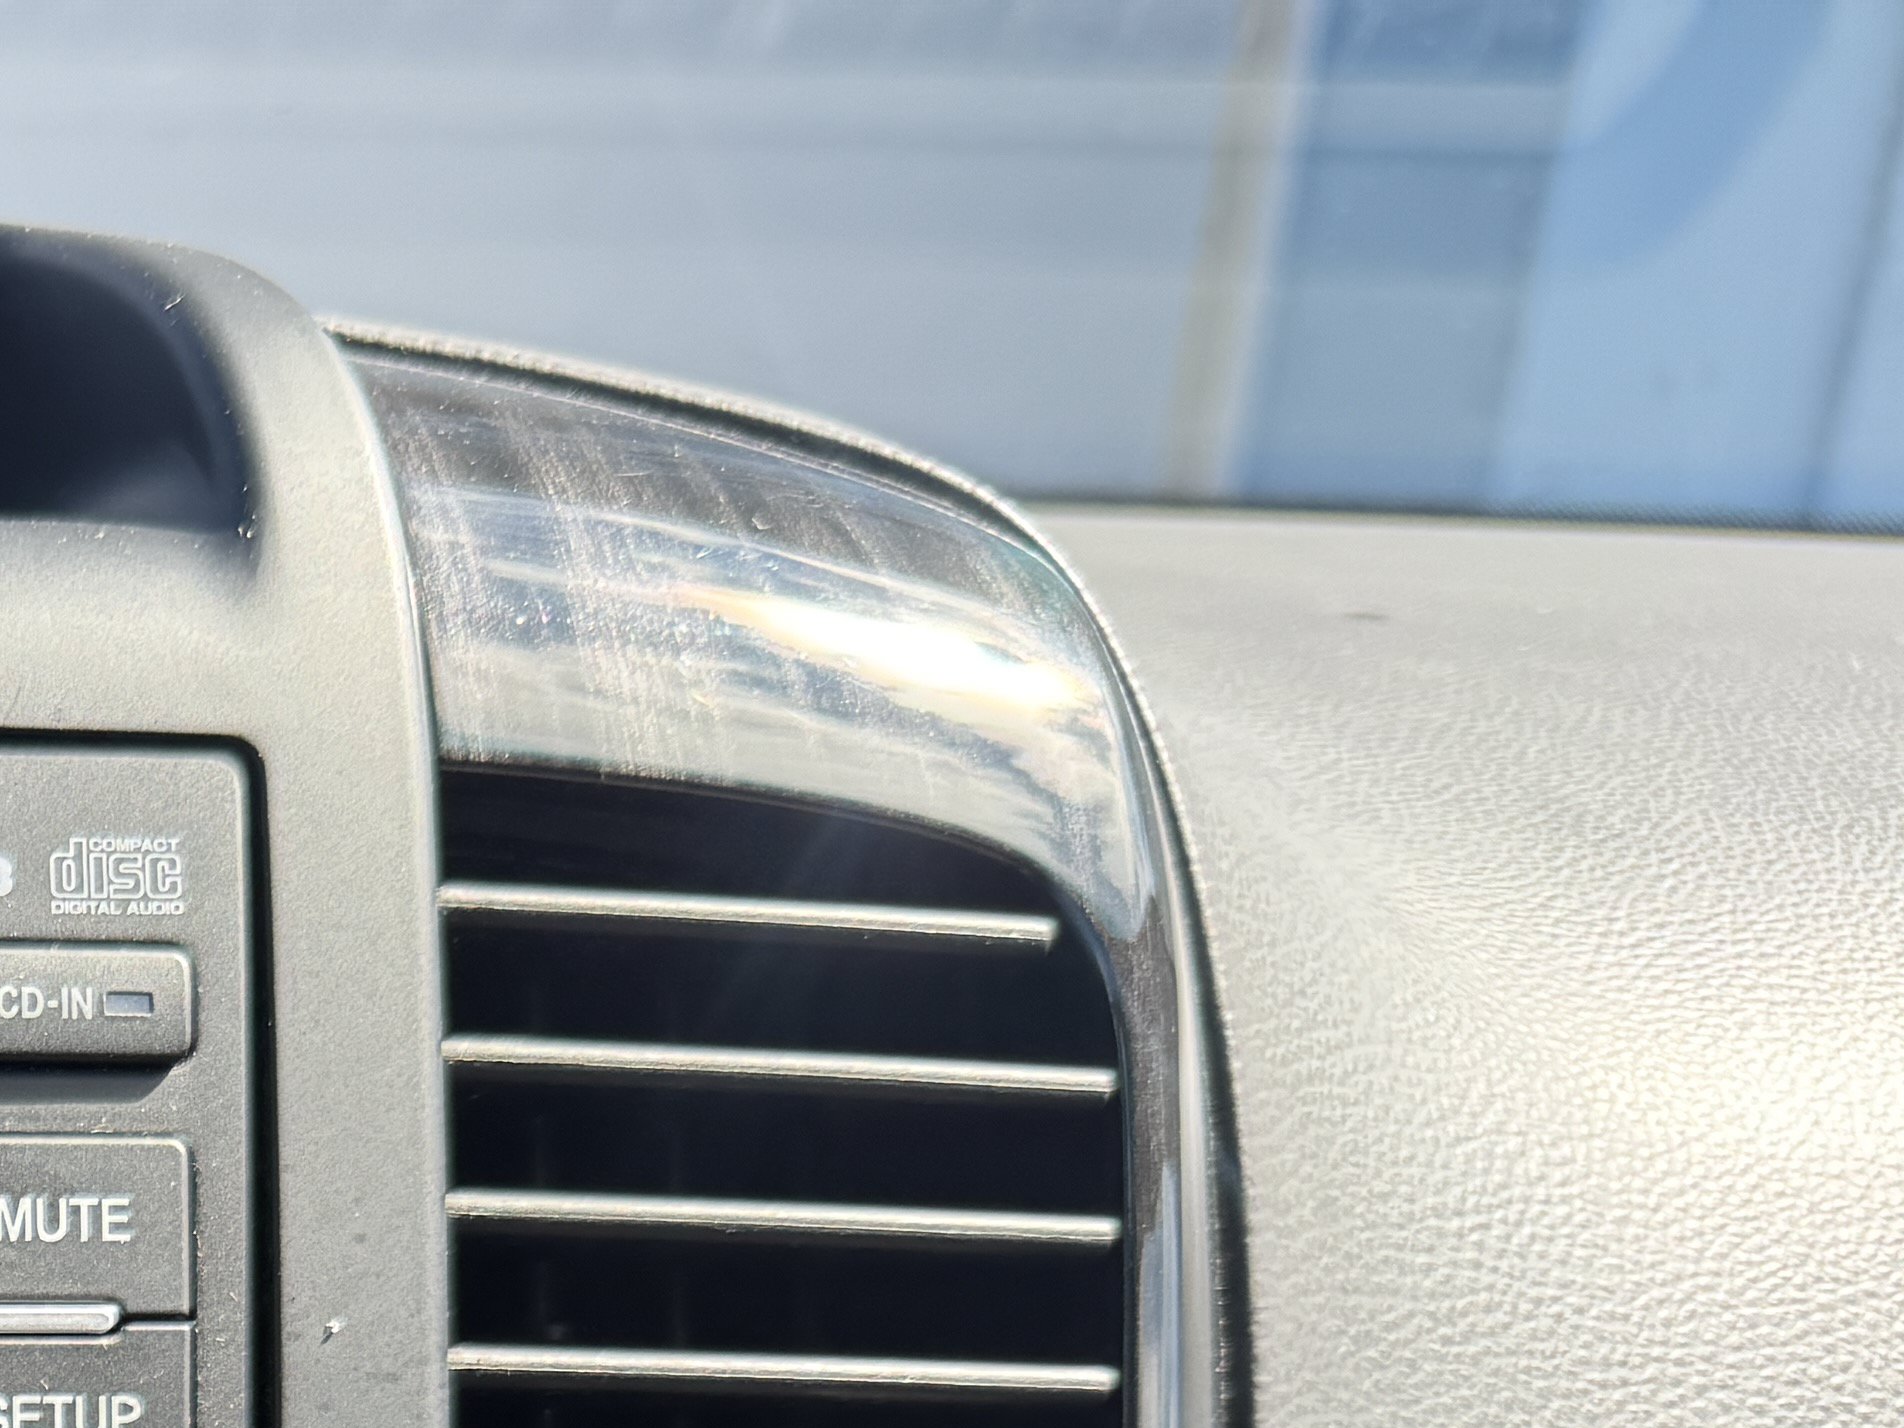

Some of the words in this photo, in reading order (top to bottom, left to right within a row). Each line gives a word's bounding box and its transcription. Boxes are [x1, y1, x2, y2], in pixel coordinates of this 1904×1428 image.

[89, 836, 180, 852] COMPACT
[50, 838, 182, 900] disc
[51, 901, 121, 916] DIGITAL
[127, 901, 184, 916] AUDIO
